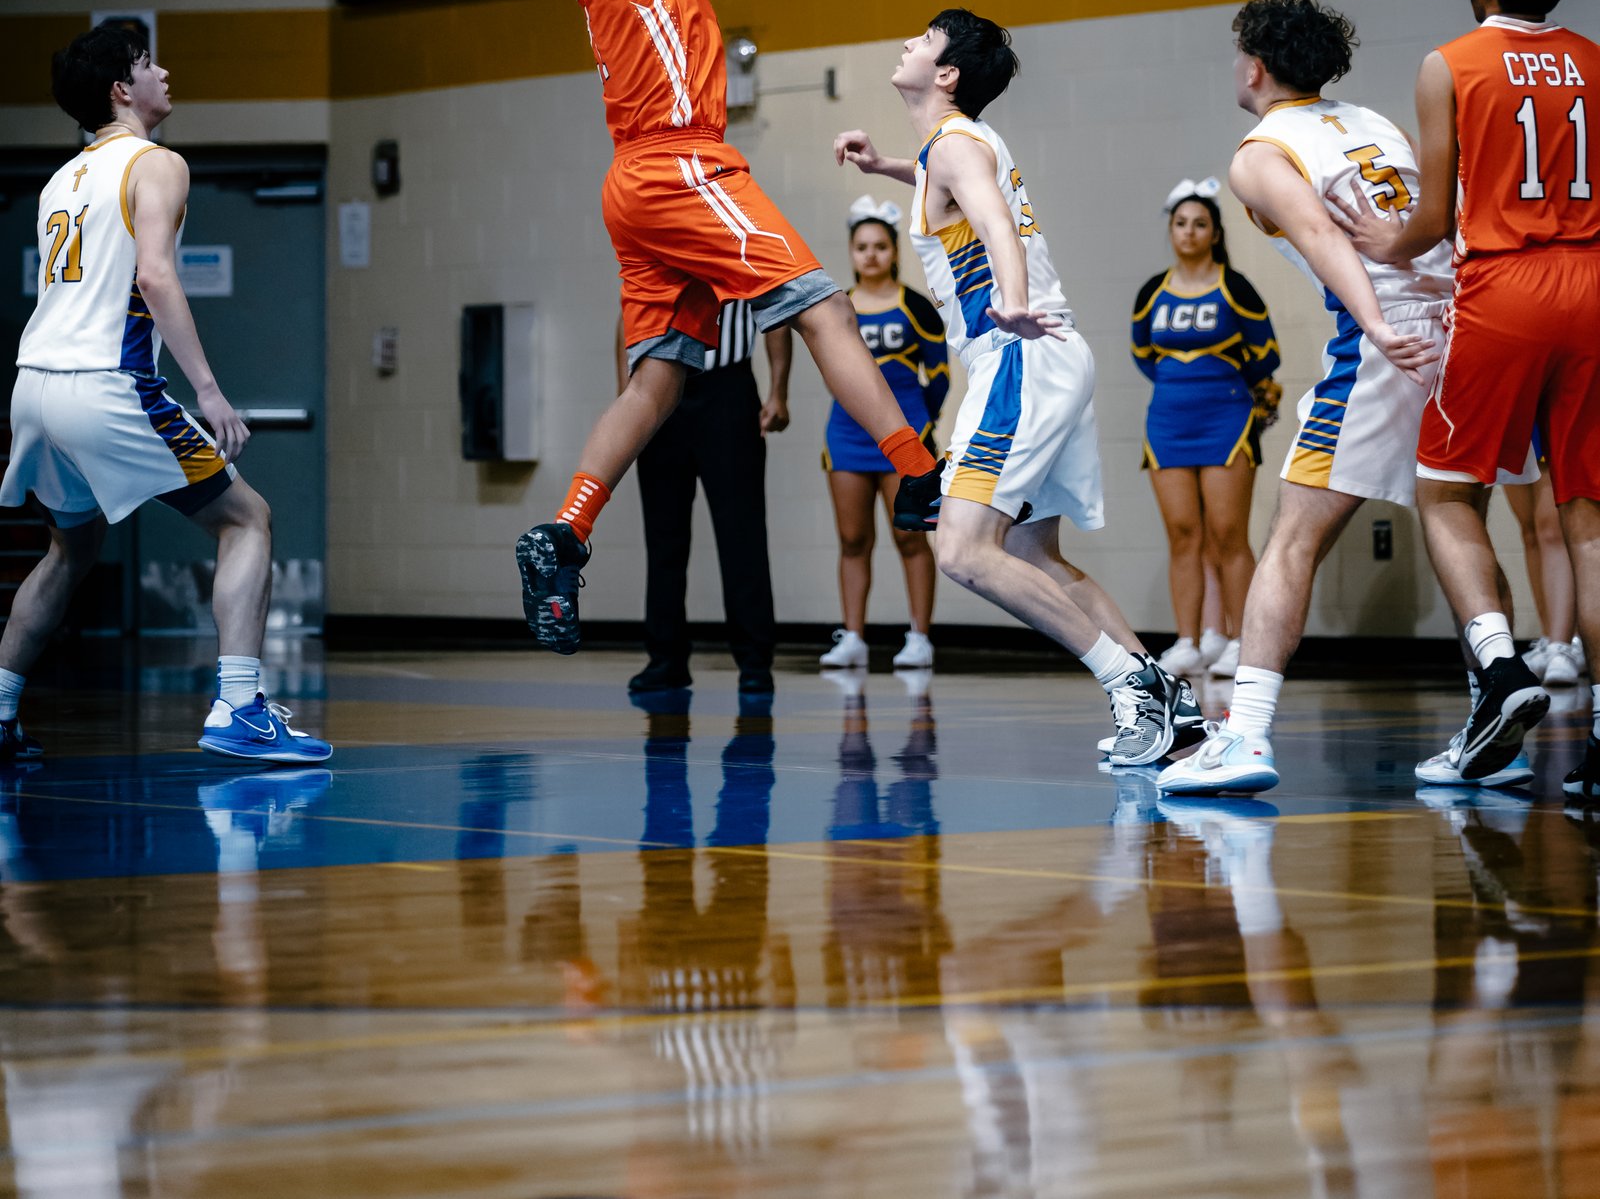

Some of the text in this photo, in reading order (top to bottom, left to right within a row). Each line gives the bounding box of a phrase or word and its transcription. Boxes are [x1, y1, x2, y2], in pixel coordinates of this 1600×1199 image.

[1502, 52, 1586, 87] CPSA
[1516, 97, 1593, 200] 11
[1344, 144, 1413, 213] 5
[45, 204, 90, 291] 21
[859, 322, 905, 350] CC
[1151, 303, 1219, 332] ACC
